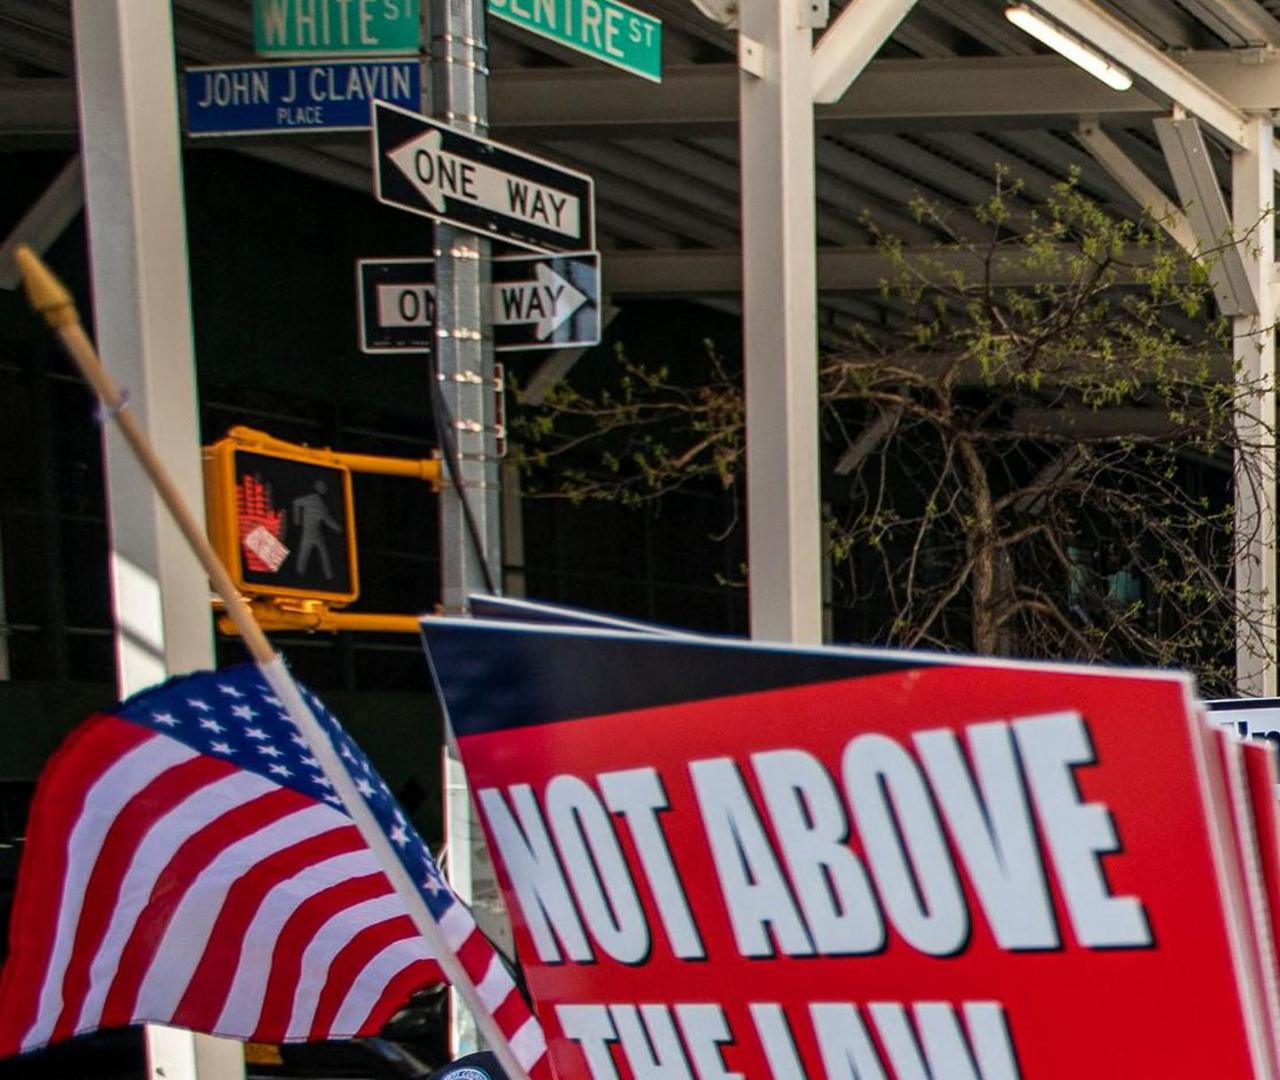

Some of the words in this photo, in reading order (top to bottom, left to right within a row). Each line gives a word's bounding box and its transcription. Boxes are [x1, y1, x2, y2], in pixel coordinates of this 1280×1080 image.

[261, 0, 378, 46] WHITE
[629, 18, 653, 47] ST
[198, 70, 269, 108] JOHN
[281, 69, 296, 103] J
[309, 65, 411, 101] CLAVIN
[277, 106, 323, 126] PLACE
[415, 149, 479, 201] ONE
[507, 179, 566, 228] WAY
[400, 289, 436, 322] ON
[502, 285, 564, 320] WAY
[478, 768, 706, 966] NOT
[688, 711, 1158, 958] ABOVE
